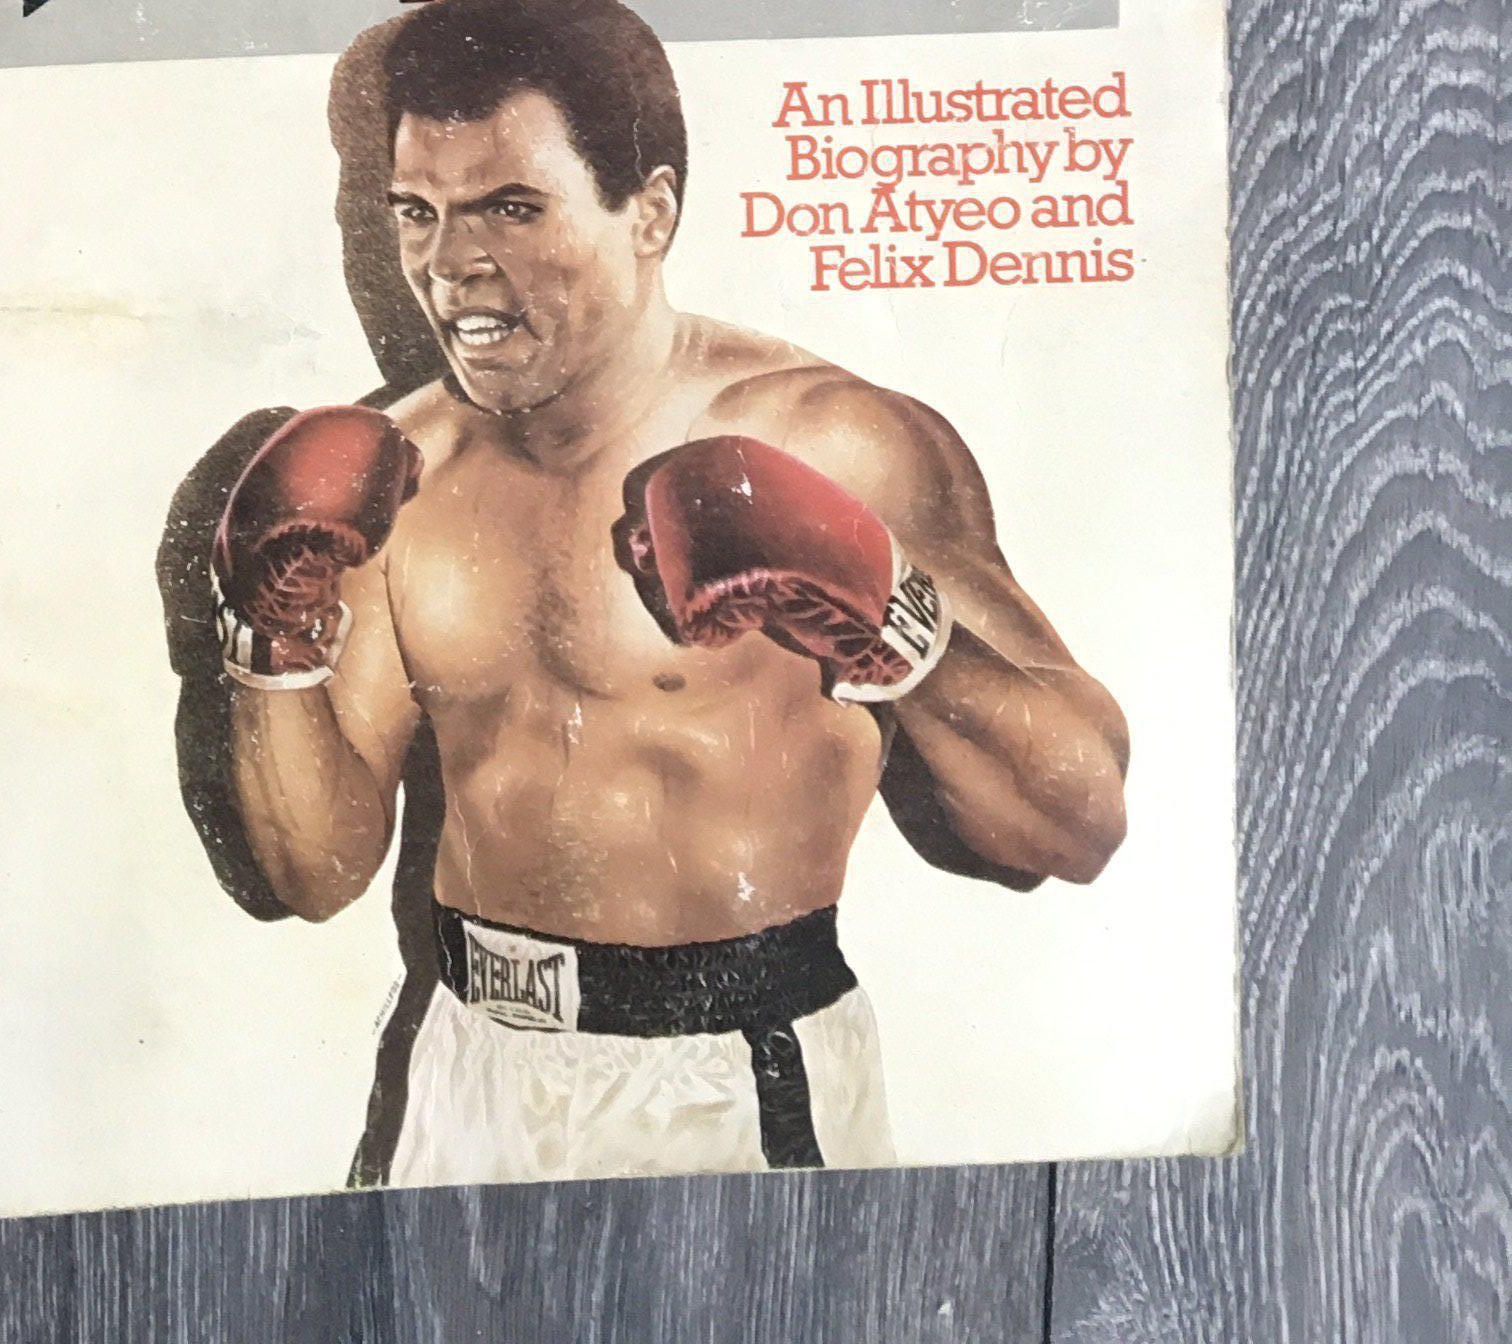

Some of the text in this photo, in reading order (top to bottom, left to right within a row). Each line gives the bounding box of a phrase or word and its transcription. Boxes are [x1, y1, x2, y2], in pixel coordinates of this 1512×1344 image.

[772, 71, 1132, 128] An Illustrated
[785, 127, 1134, 187] Biography by
[740, 180, 1134, 241] Don Atyeo and
[810, 238, 1134, 291] Felix Dennis
[467, 930, 565, 1023] EVERLAST
